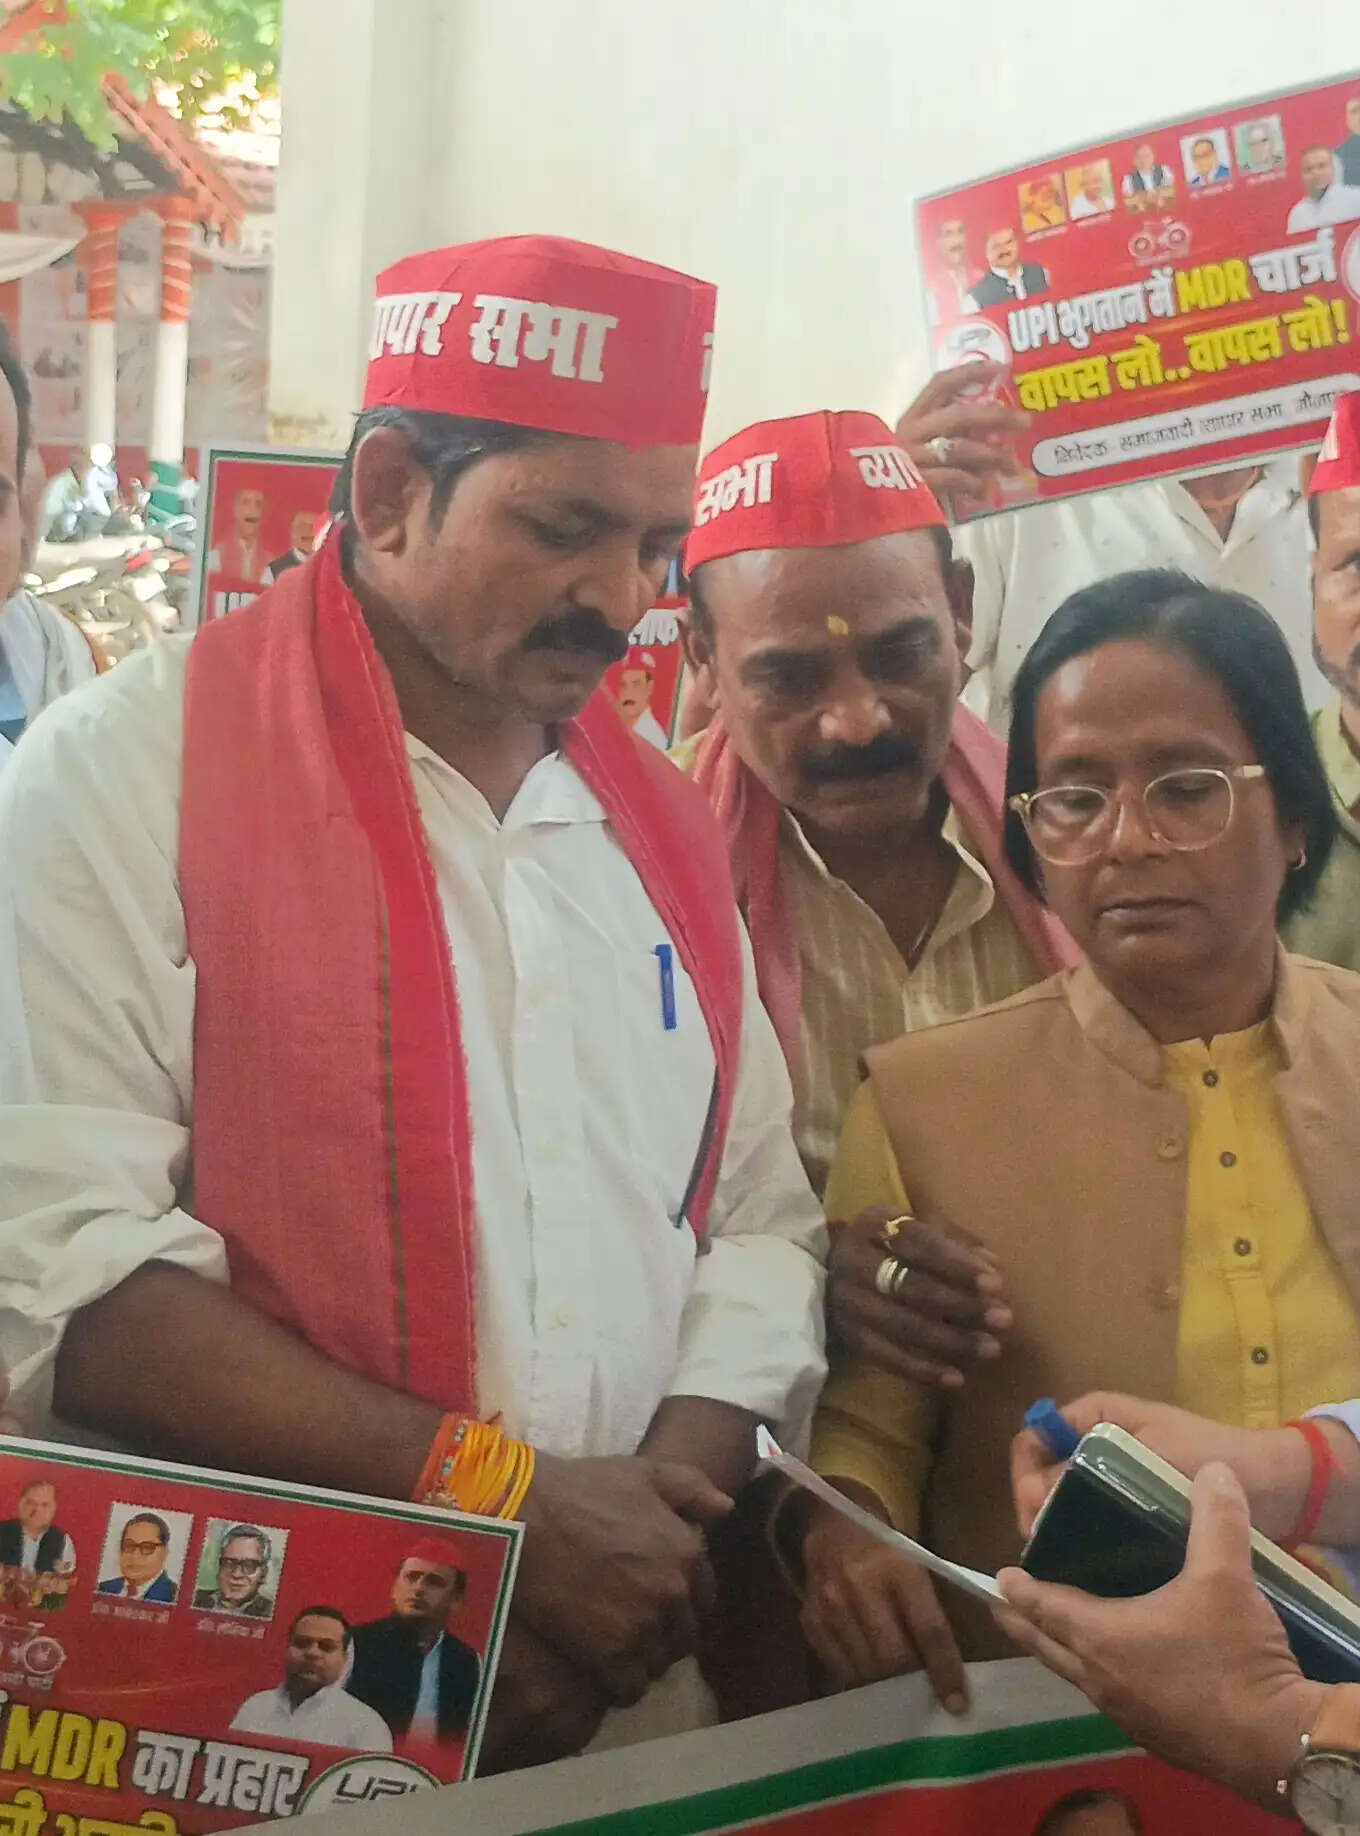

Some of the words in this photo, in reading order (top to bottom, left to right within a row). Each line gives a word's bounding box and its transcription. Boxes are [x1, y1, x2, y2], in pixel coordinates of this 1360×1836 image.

[470, 294, 619, 383] सभा
[1008, 301, 1060, 352] UPI
[1058, 283, 1148, 349] भुगतान
[1145, 266, 1177, 317] में
[1175, 259, 1251, 313] MDR
[1249, 227, 1338, 293] चार्ज
[1014, 355, 1112, 412] वापस
[1282, 296, 1351, 352] लो!
[694, 452, 779, 527] सभा
[0, 1705, 127, 1790] MDR
[132, 1729, 206, 1801] का
[198, 1741, 310, 1817] प्रहार
